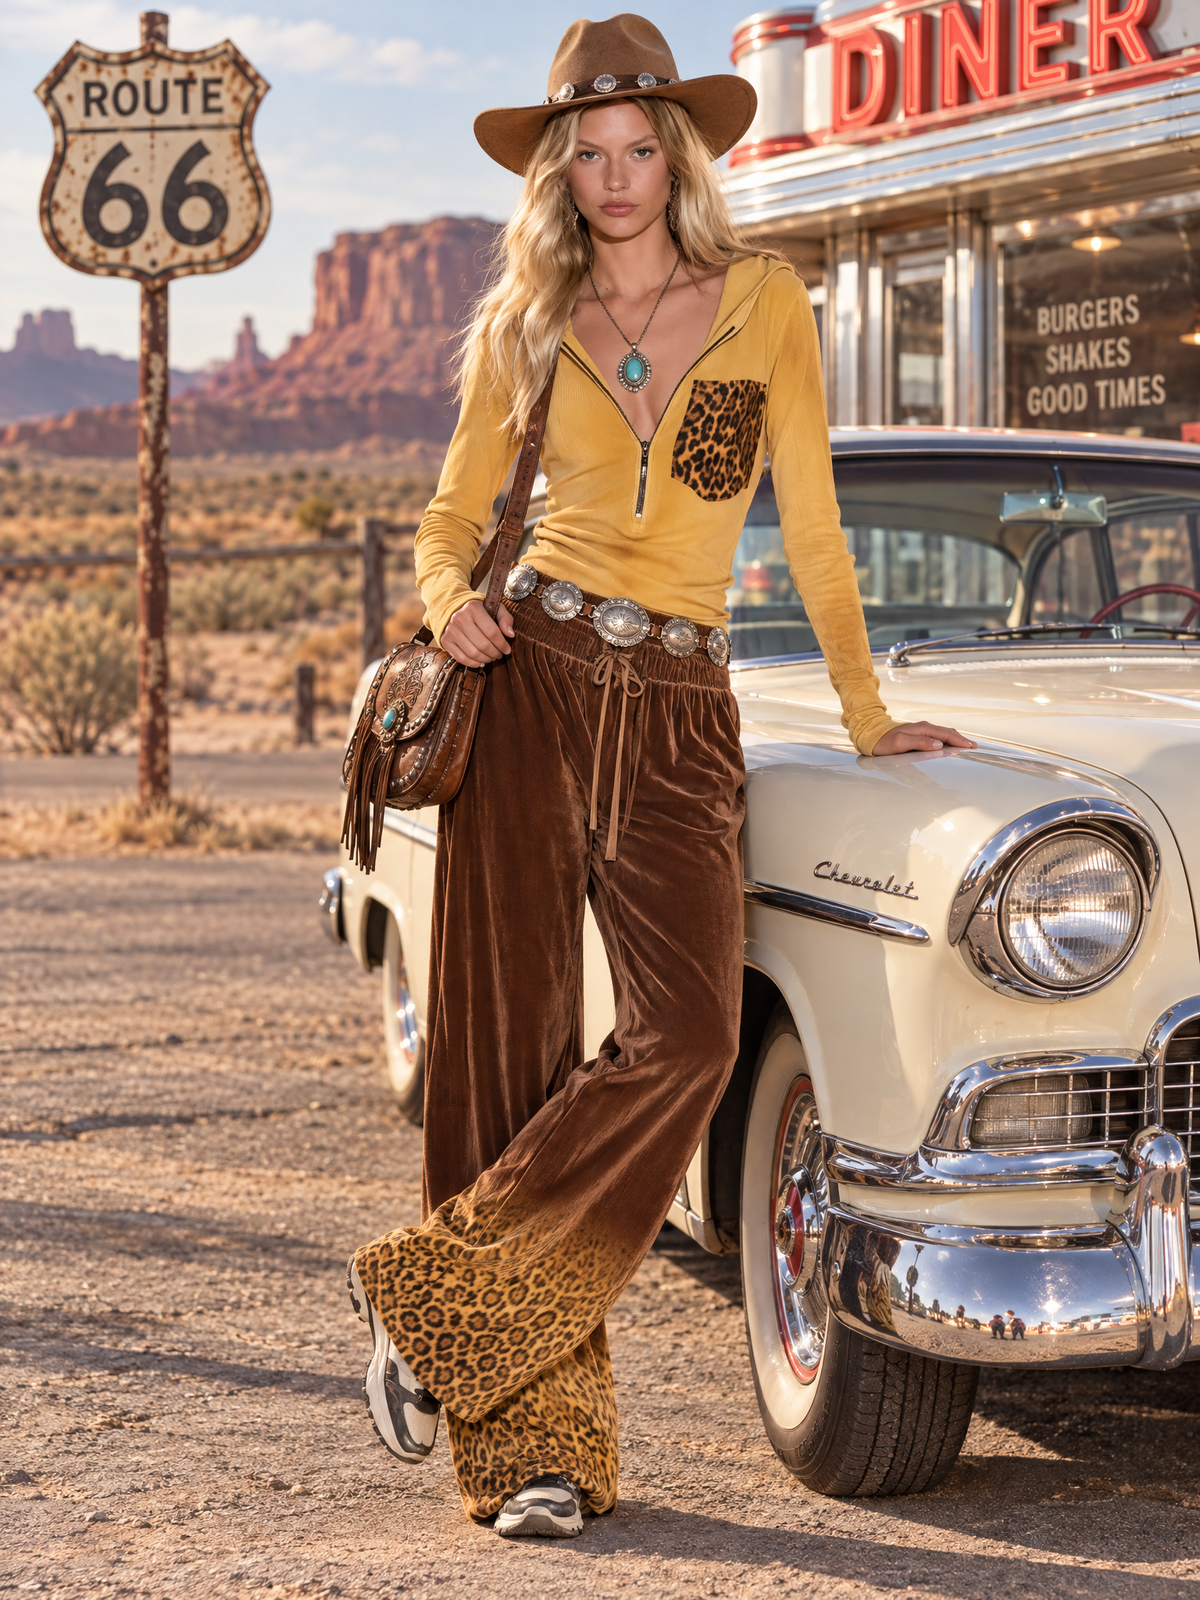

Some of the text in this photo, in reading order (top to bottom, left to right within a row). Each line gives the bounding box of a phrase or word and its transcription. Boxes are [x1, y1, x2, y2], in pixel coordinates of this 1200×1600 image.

[831, 0, 1160, 133] DINER
[83, 79, 223, 117] ROUTE
[82, 140, 229, 248] 66
[1037, 294, 1140, 336] BURGERS
[1045, 337, 1132, 375] SHAKES
[1026, 374, 1167, 416] GOOD TIMES
[813, 861, 919, 900] Chevrolet
